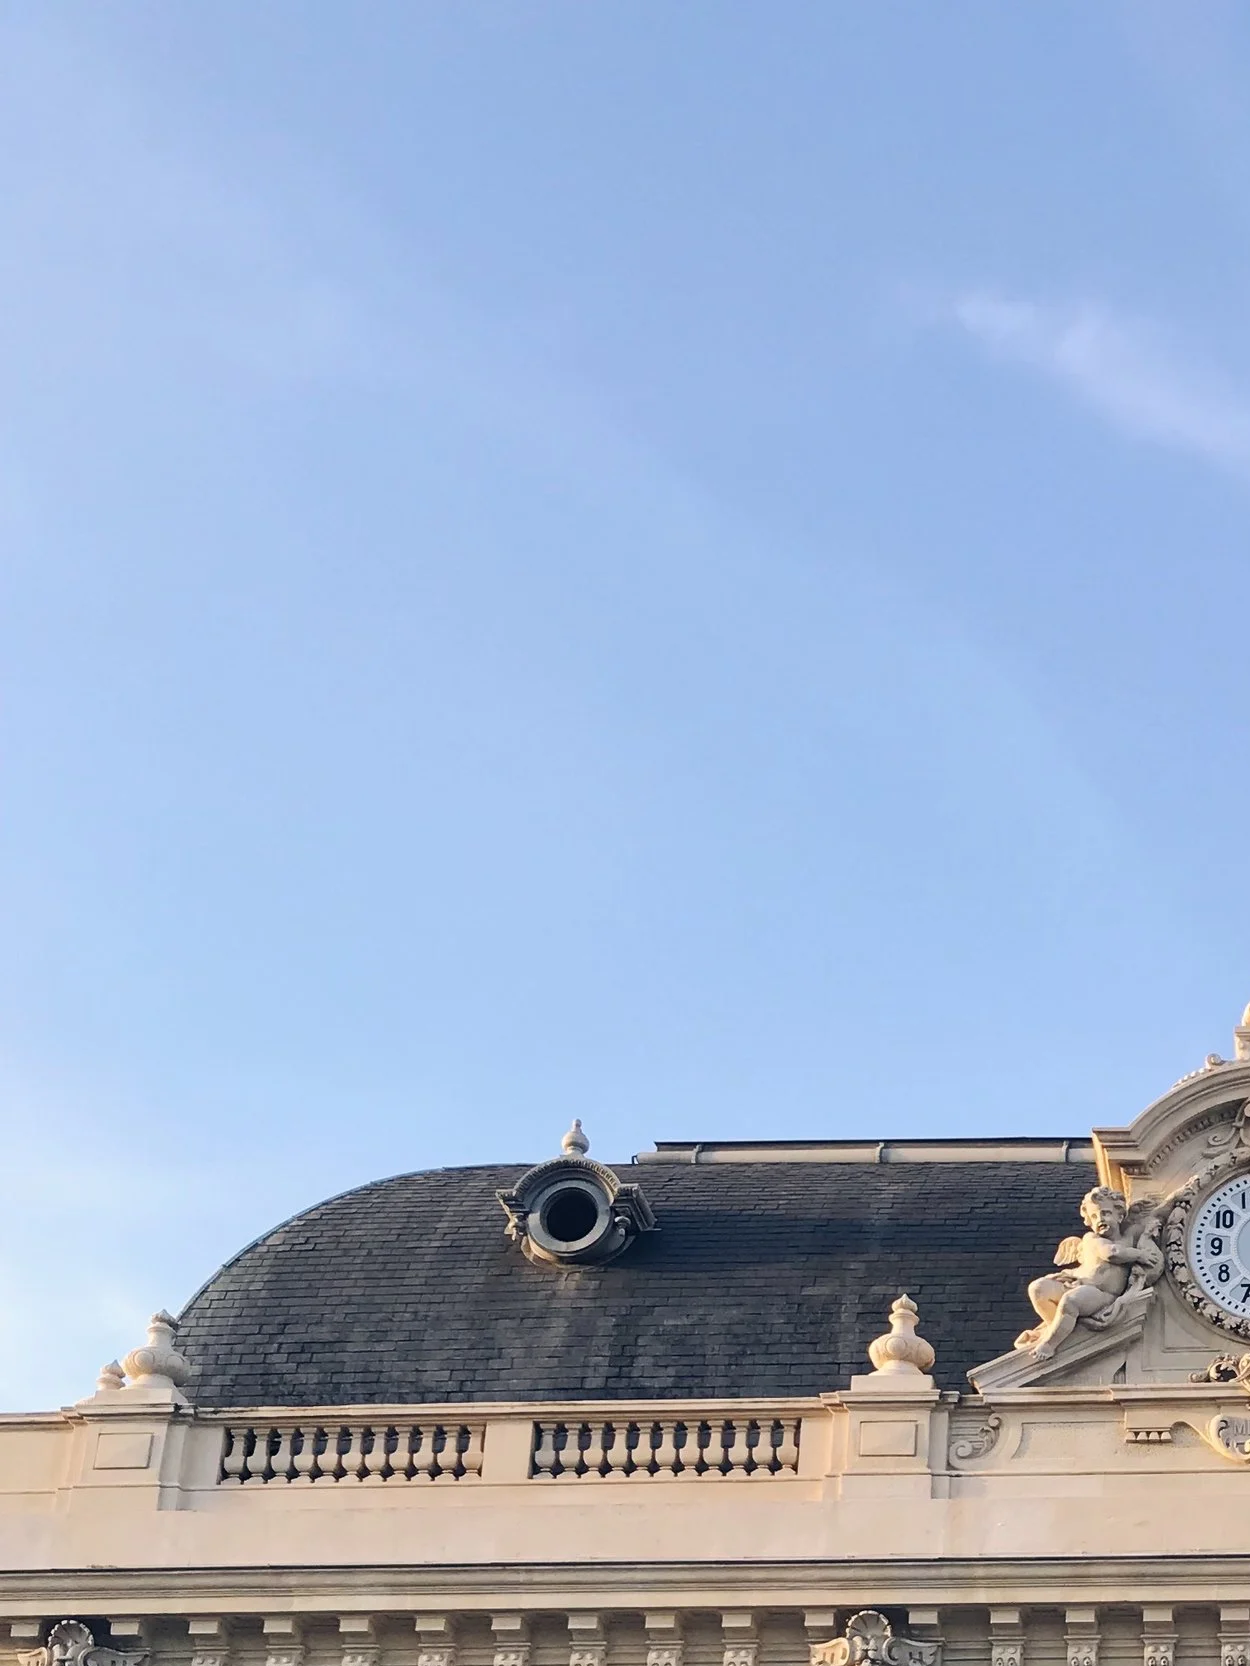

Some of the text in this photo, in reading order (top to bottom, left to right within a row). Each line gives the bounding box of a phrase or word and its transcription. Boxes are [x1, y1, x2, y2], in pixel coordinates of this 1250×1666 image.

[1215, 1210, 1234, 1228] 10
[1210, 1237, 1223, 1256] 9
[1218, 1264, 1230, 1282] 8
